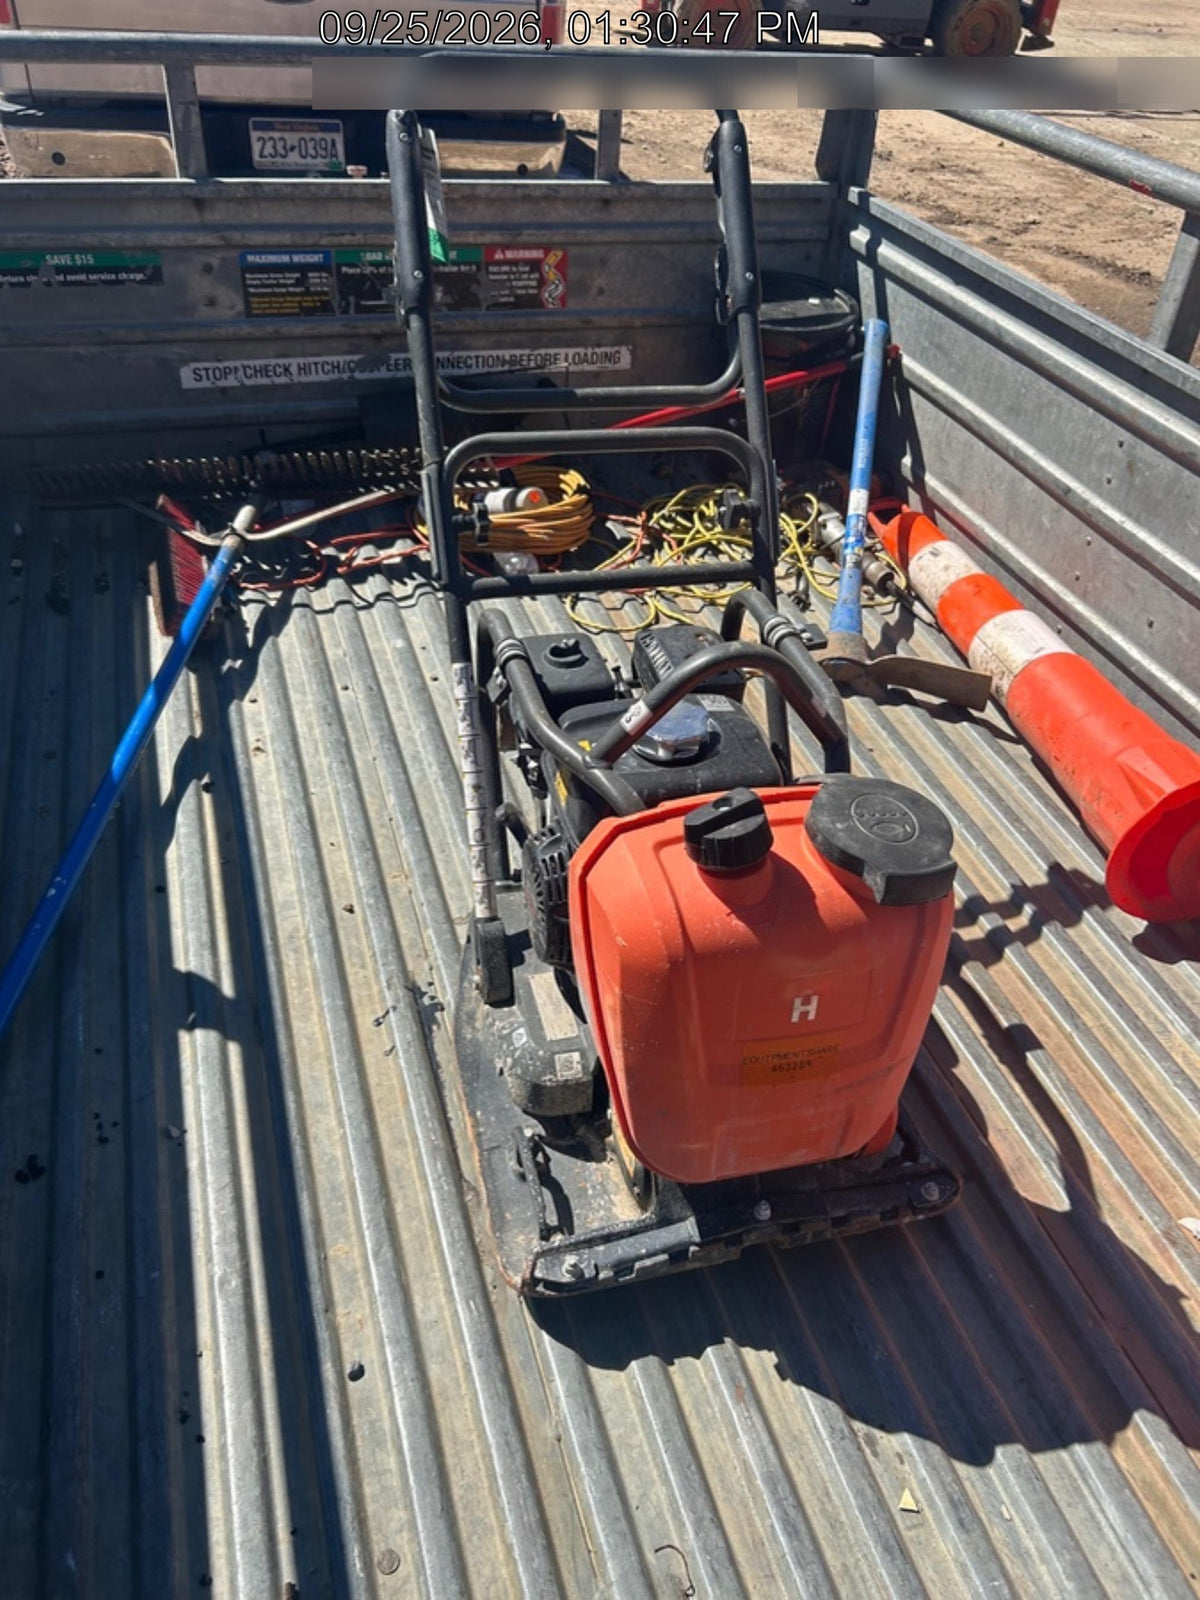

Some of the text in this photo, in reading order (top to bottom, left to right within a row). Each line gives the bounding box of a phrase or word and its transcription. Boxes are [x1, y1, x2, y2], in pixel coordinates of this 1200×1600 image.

[45, 254, 95, 265] SAVE $15
[291, 253, 325, 263] WEIGHT
[504, 249, 545, 259] WARNING
[192, 366, 239, 383] STOP!
[242, 362, 294, 380] CHECK
[509, 353, 561, 367] BEFORE
[565, 350, 621, 366] LOADING
[791, 995, 819, 1023] H
